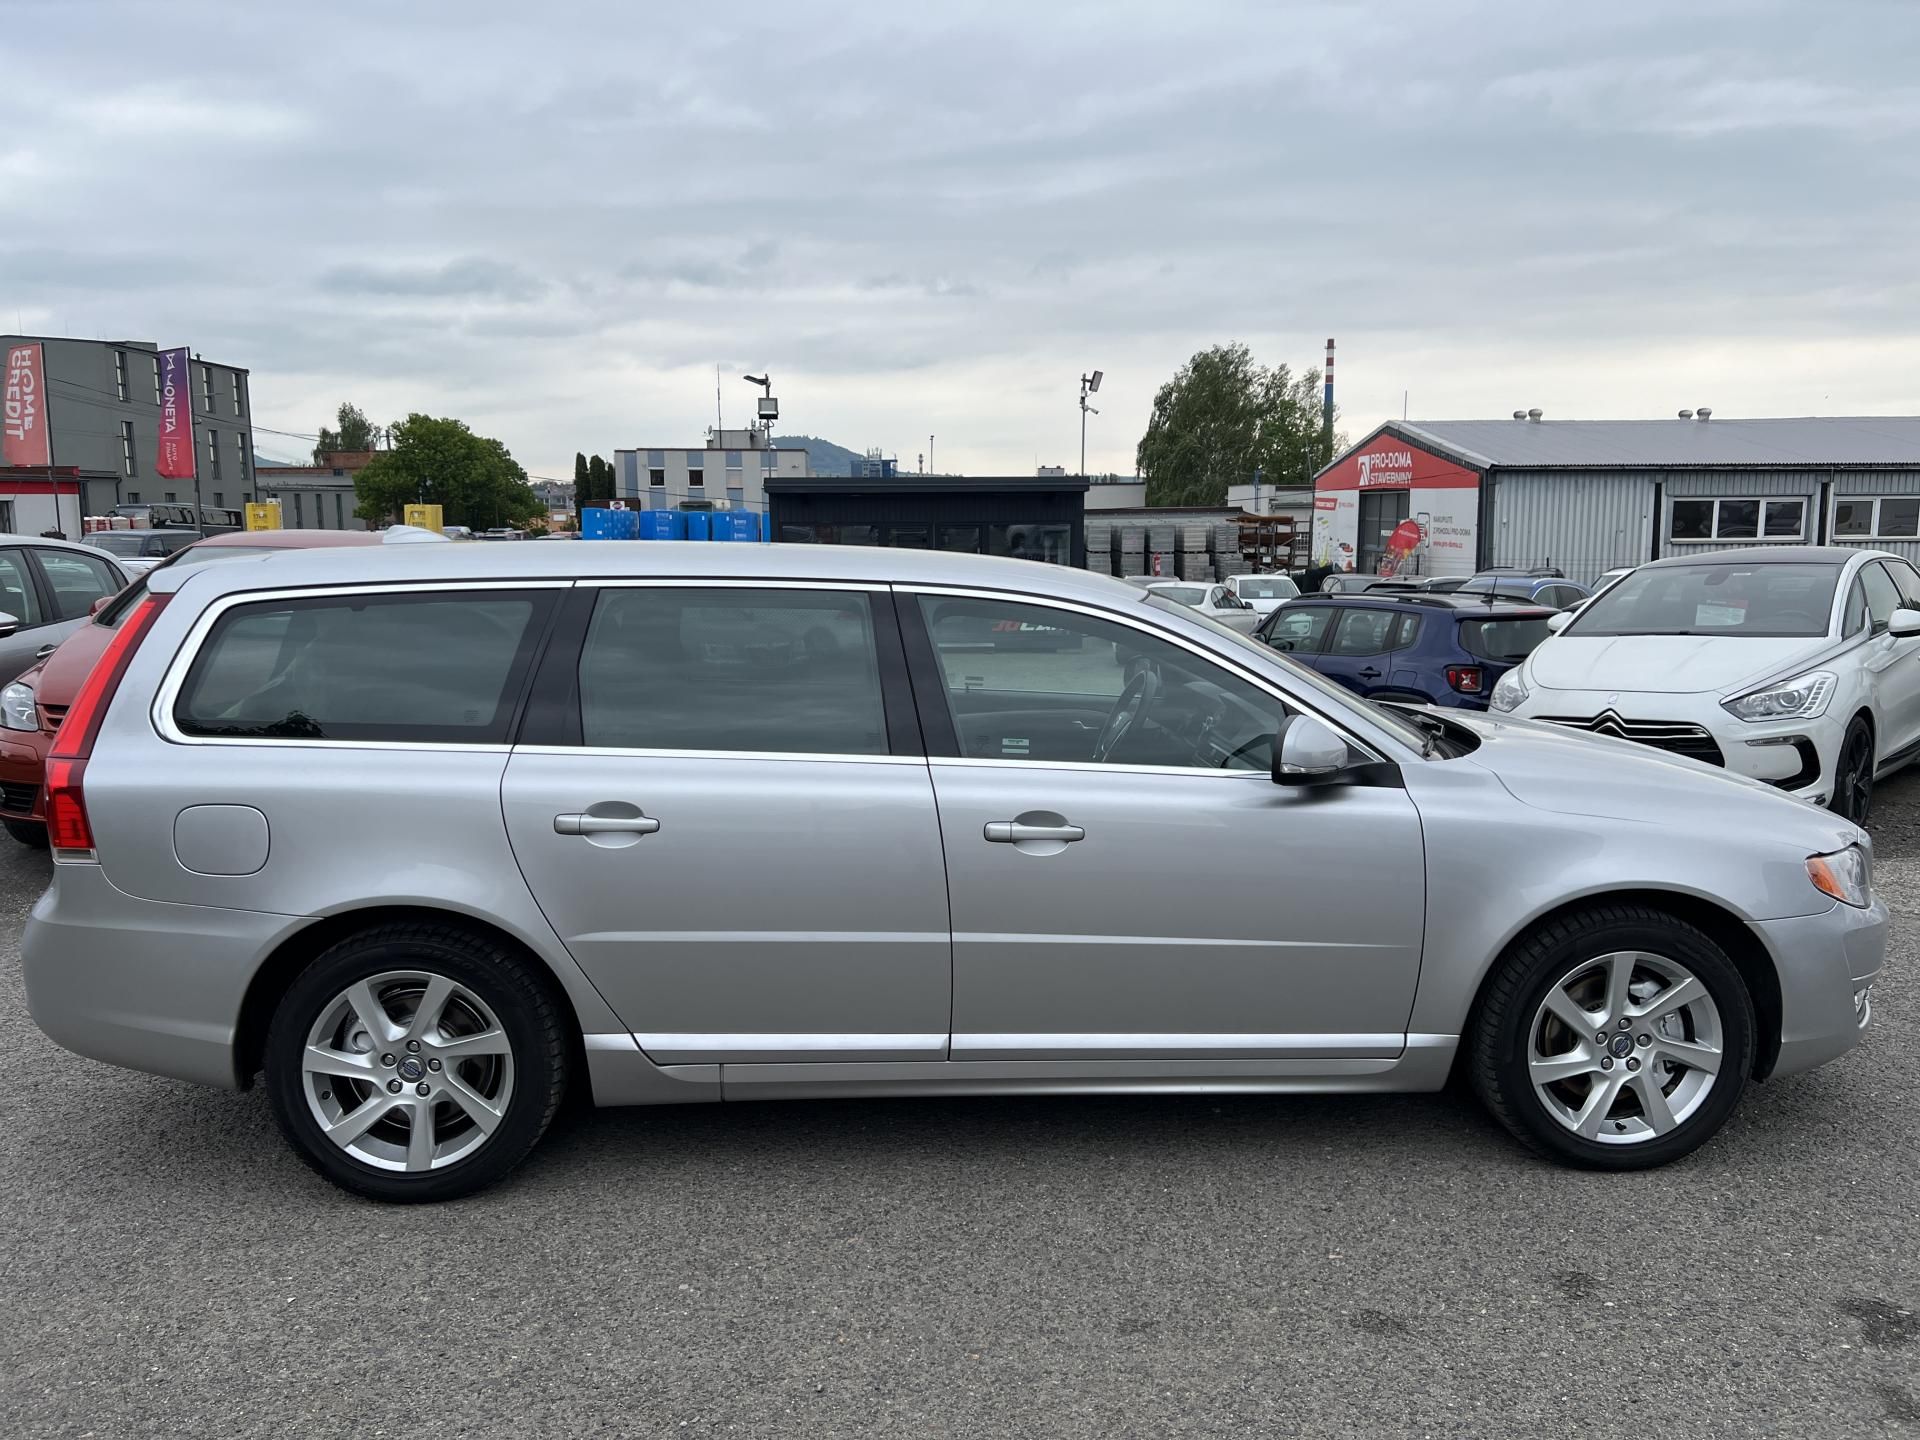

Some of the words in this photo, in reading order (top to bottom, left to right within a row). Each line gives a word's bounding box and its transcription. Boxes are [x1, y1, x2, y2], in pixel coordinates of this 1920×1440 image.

[5, 350, 25, 441] CREDIT
[21, 349, 35, 431] HOME
[1370, 451, 1413, 469] PRO-DOMA
[1370, 471, 1413, 486] STAVEBNINY
